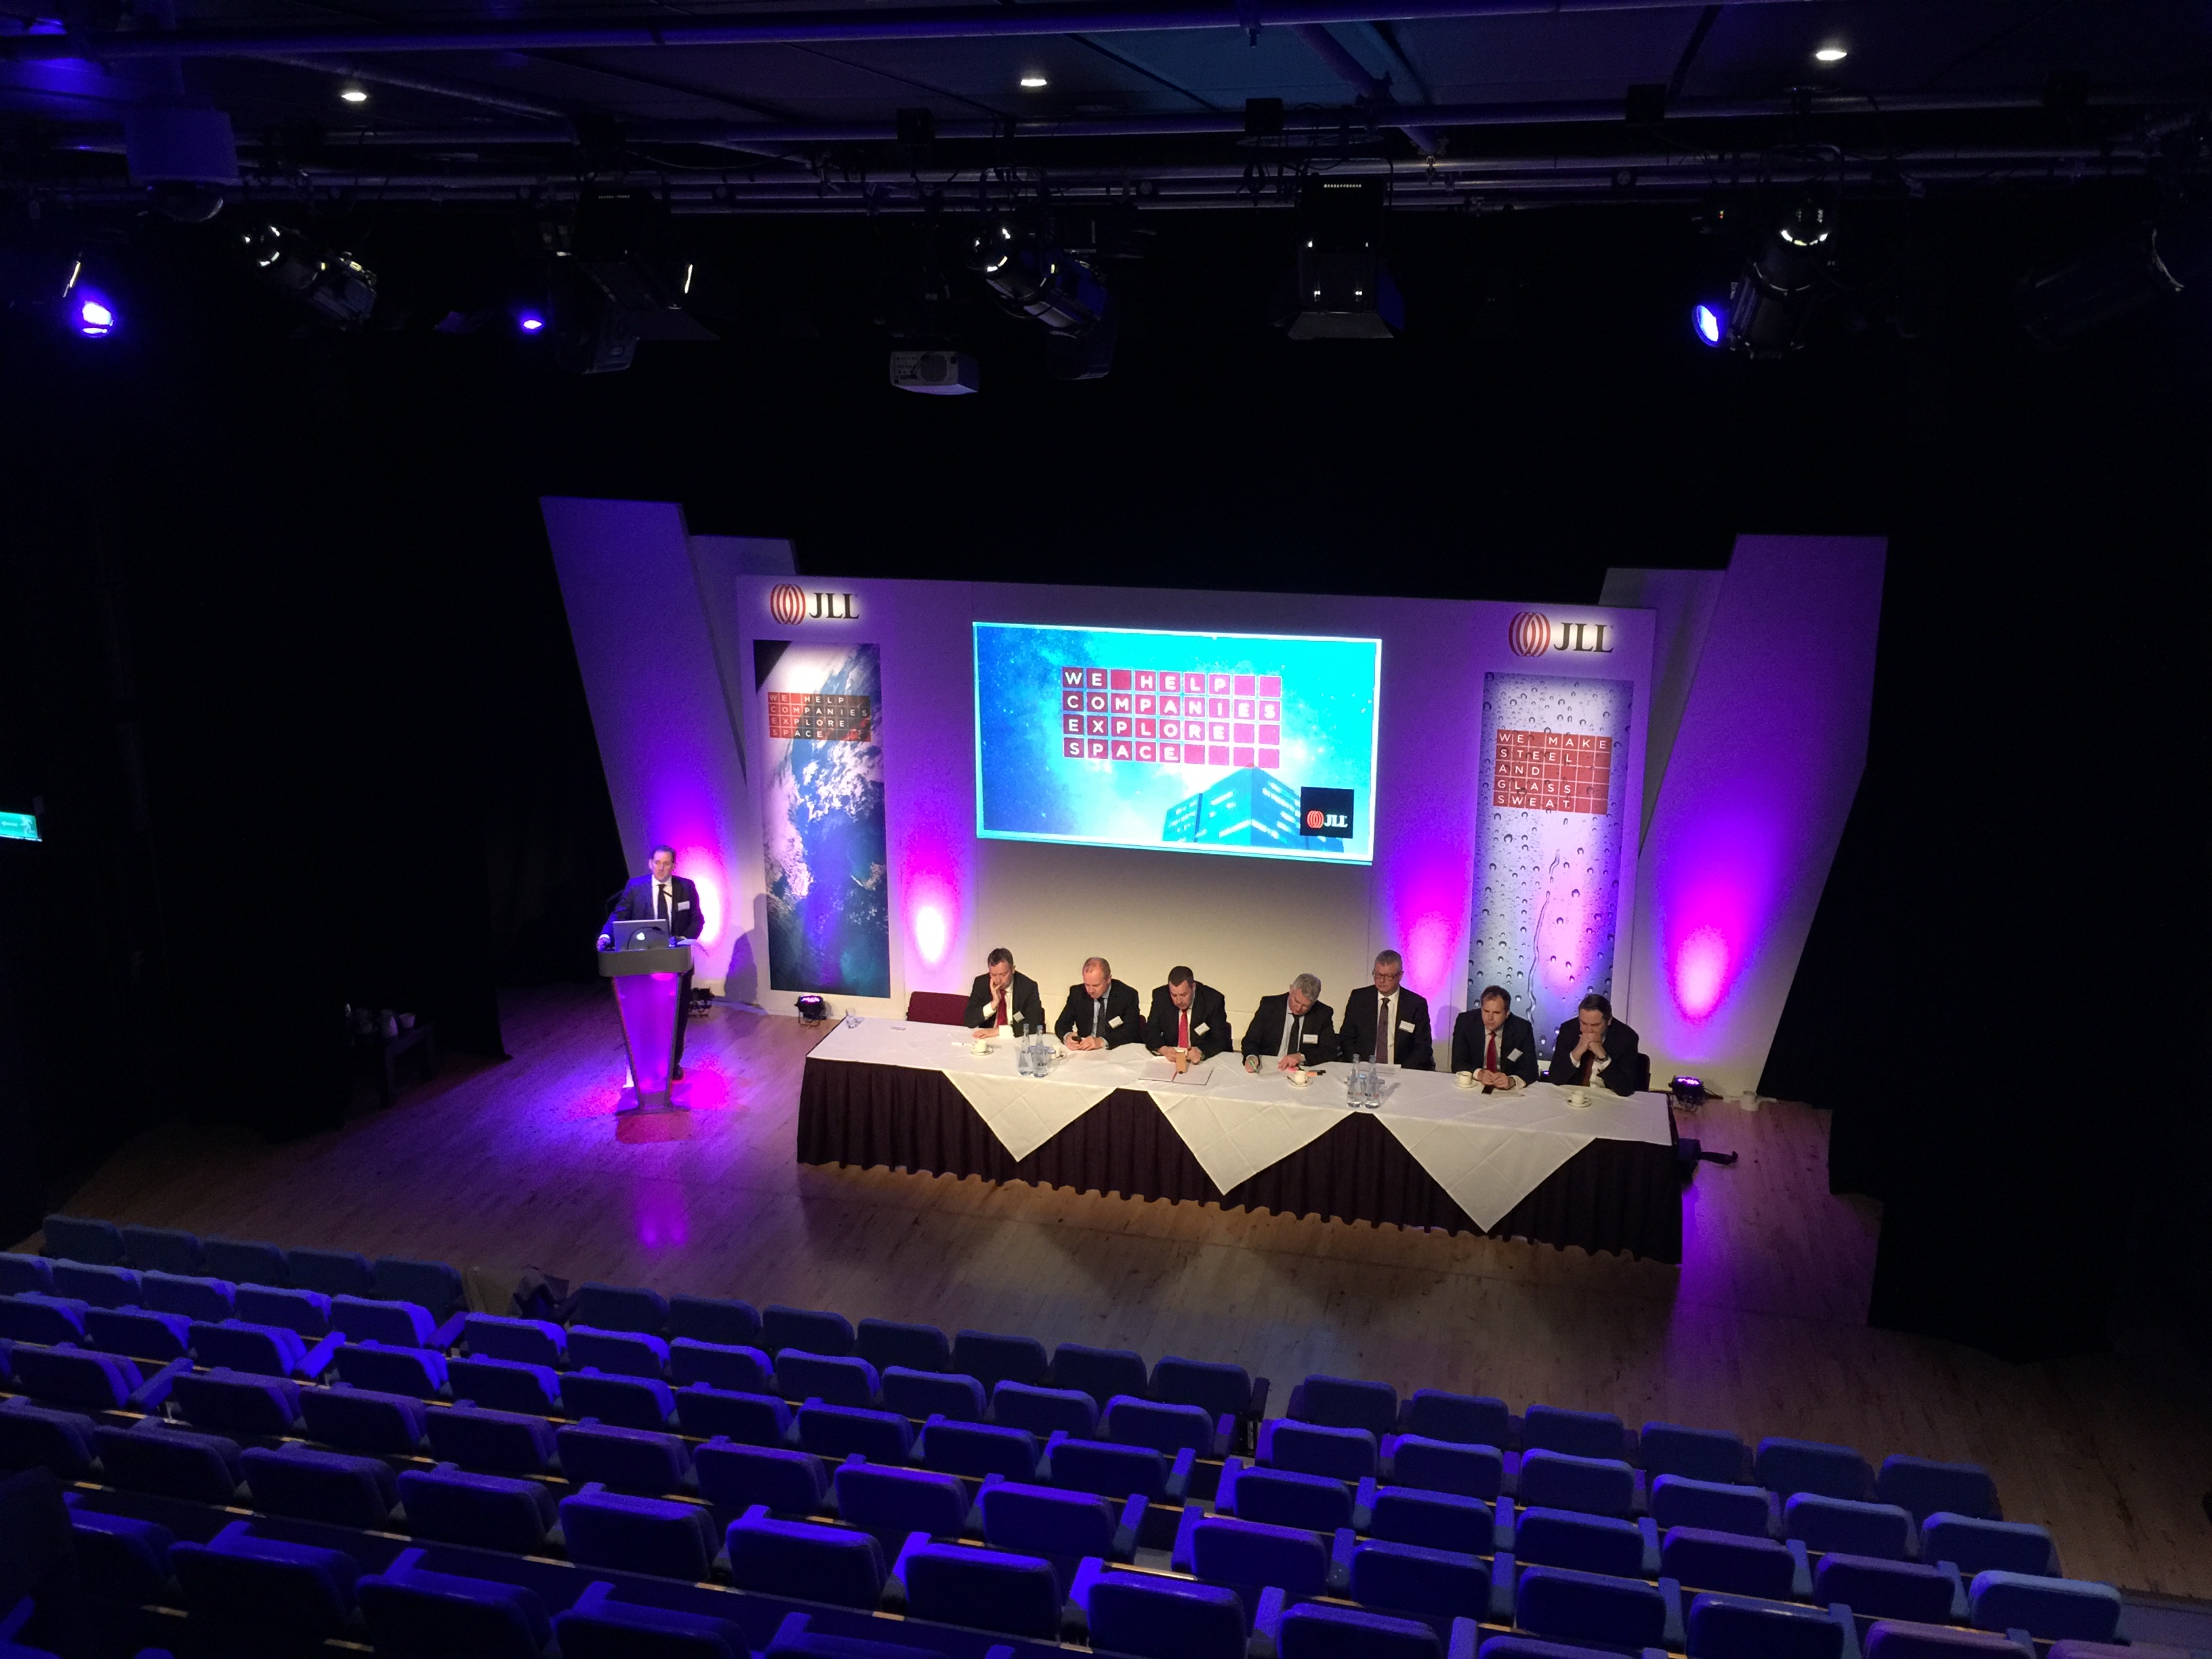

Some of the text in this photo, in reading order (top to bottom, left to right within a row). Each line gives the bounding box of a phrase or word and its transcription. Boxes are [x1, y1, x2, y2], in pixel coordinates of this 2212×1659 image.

[809, 592, 859, 619] JLL
[1554, 622, 1614, 653] JLL
[1065, 670, 1227, 692] WE HELP
[770, 694, 787, 703] WE
[771, 705, 867, 716] COMPANIES
[1067, 695, 1276, 719] COMPANIES
[771, 717, 845, 727] EXPLORE
[1068, 718, 1225, 740] EXPLORE
[772, 729, 822, 738] SPACE
[1499, 733, 1607, 749] WE MAKE
[1069, 741, 1179, 761] SPACE
[1500, 748, 1572, 763] STEEL
[1498, 764, 1540, 775] AND
[1498, 779, 1572, 794] GLASS
[1498, 794, 1570, 809] SWEAT
[1324, 814, 1348, 827] JLL
